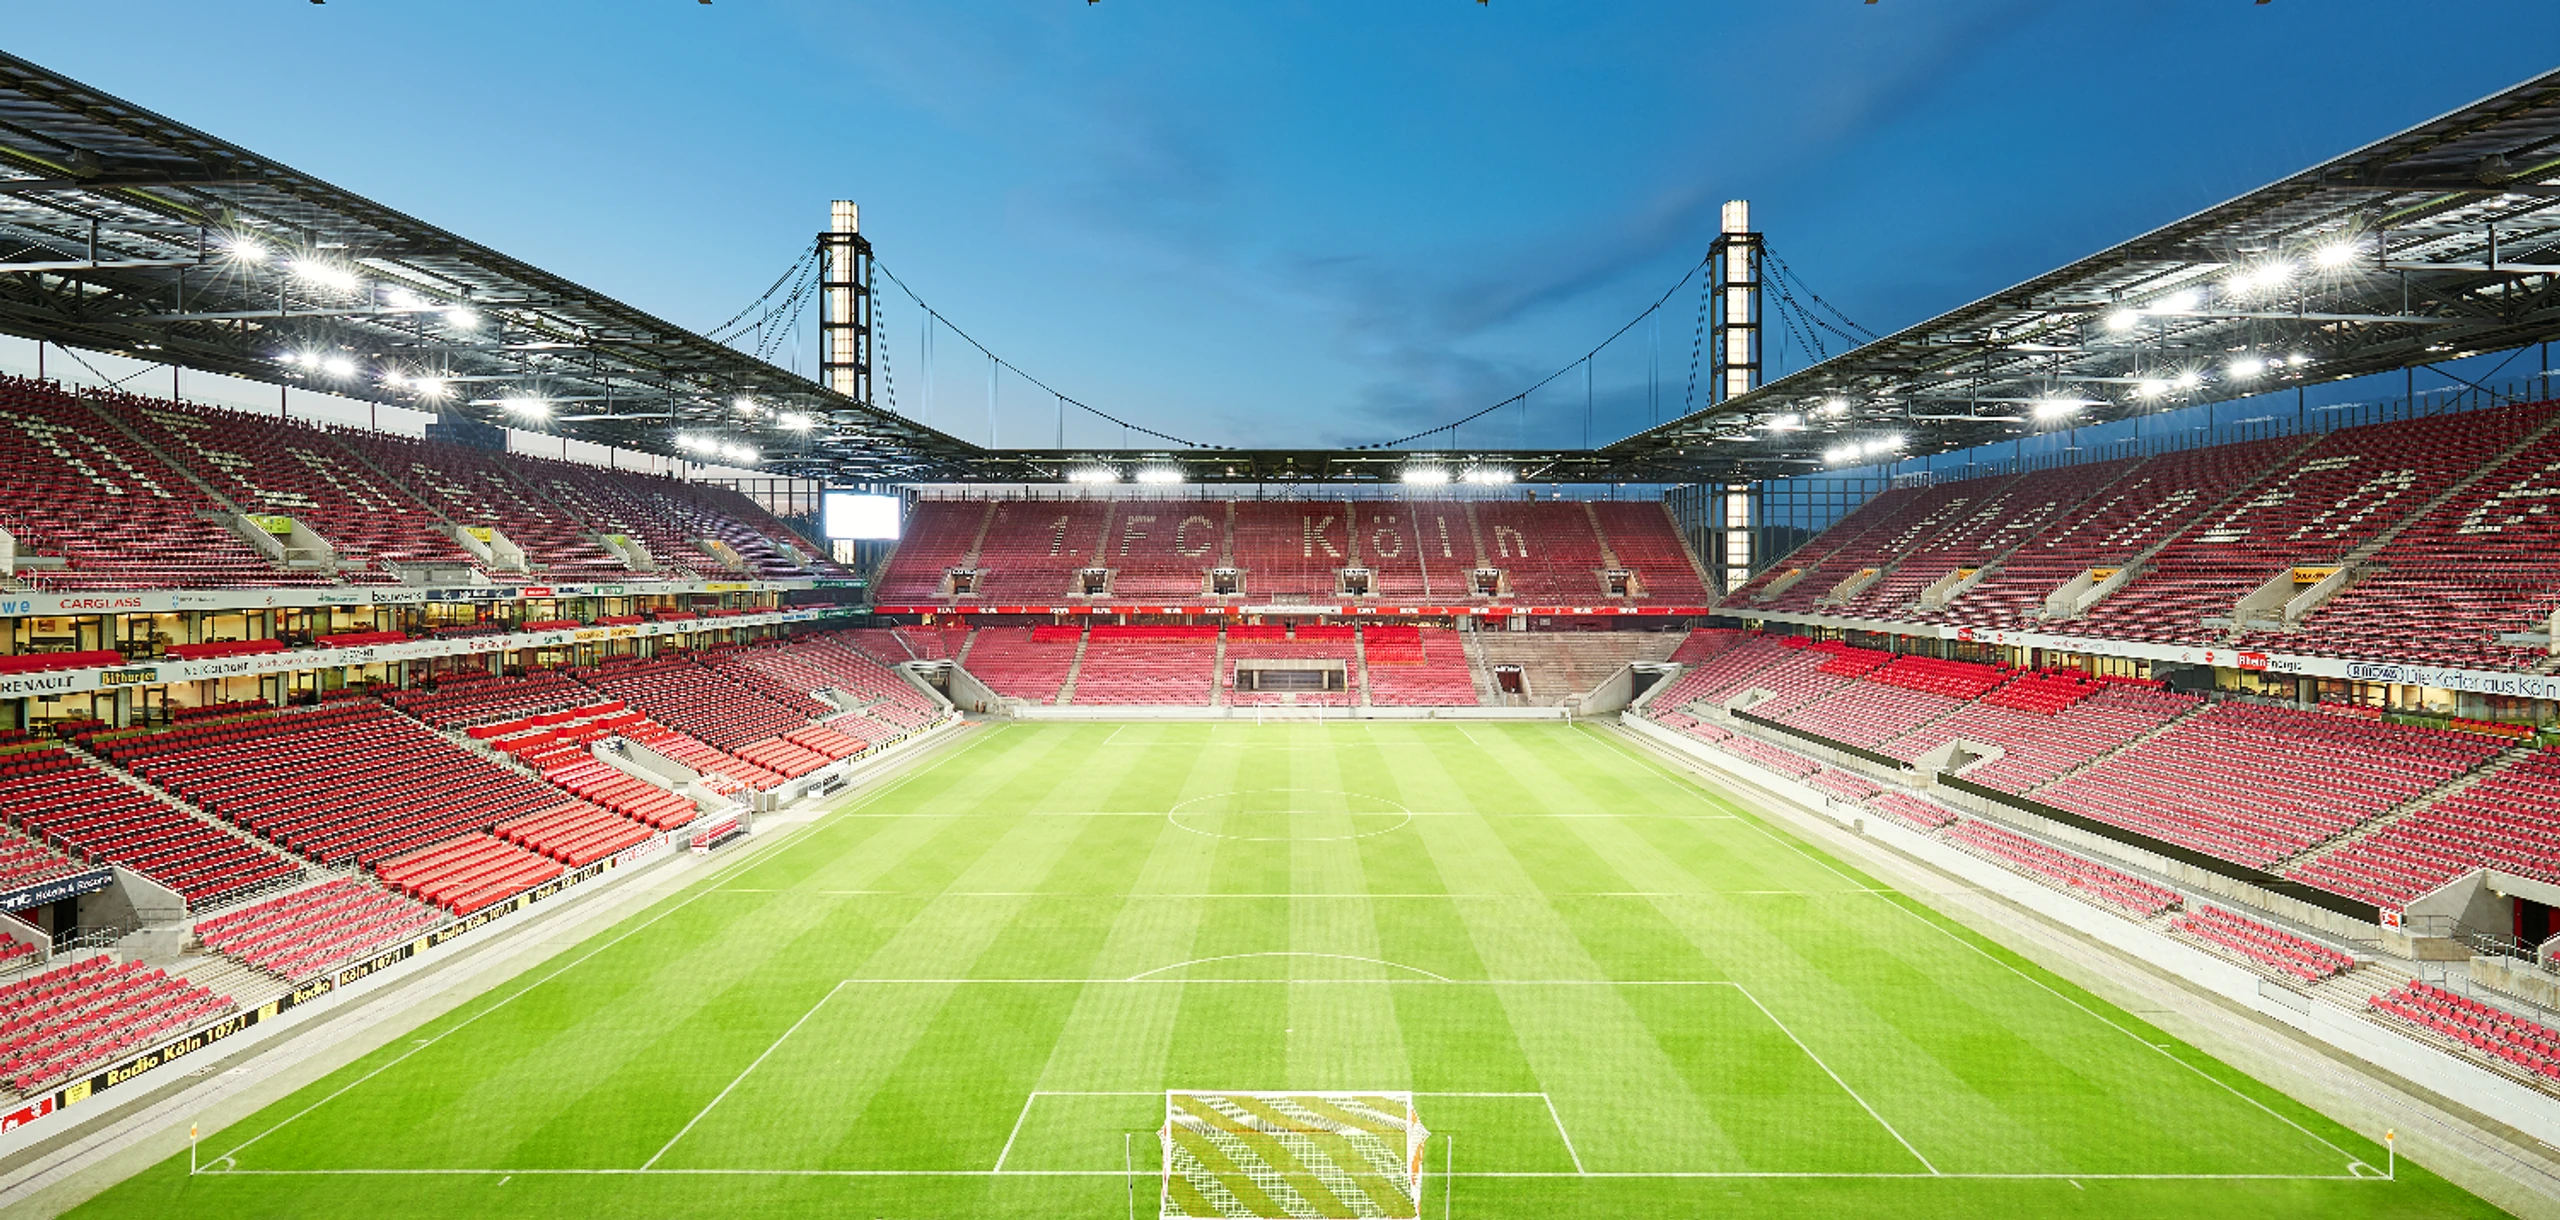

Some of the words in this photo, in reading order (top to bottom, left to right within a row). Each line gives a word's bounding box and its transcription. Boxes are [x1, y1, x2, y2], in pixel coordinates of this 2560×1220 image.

[1119, 515, 1214, 556] FC
[1303, 515, 1528, 557] Köln
[59, 597, 141, 609] CARGLASS
[1, 676, 74, 693] RENAULT
[101, 672, 156, 686] Bitburger
[2406, 670, 2430, 686] Die
[2483, 677, 2515, 693] aus
[2519, 678, 2557, 697] Köln
[293, 981, 331, 1004] Radio
[341, 964, 369, 985] Köln
[107, 1055, 158, 1087] Radio
[163, 1034, 202, 1062] Köln
[205, 1016, 247, 1044] 107,1
